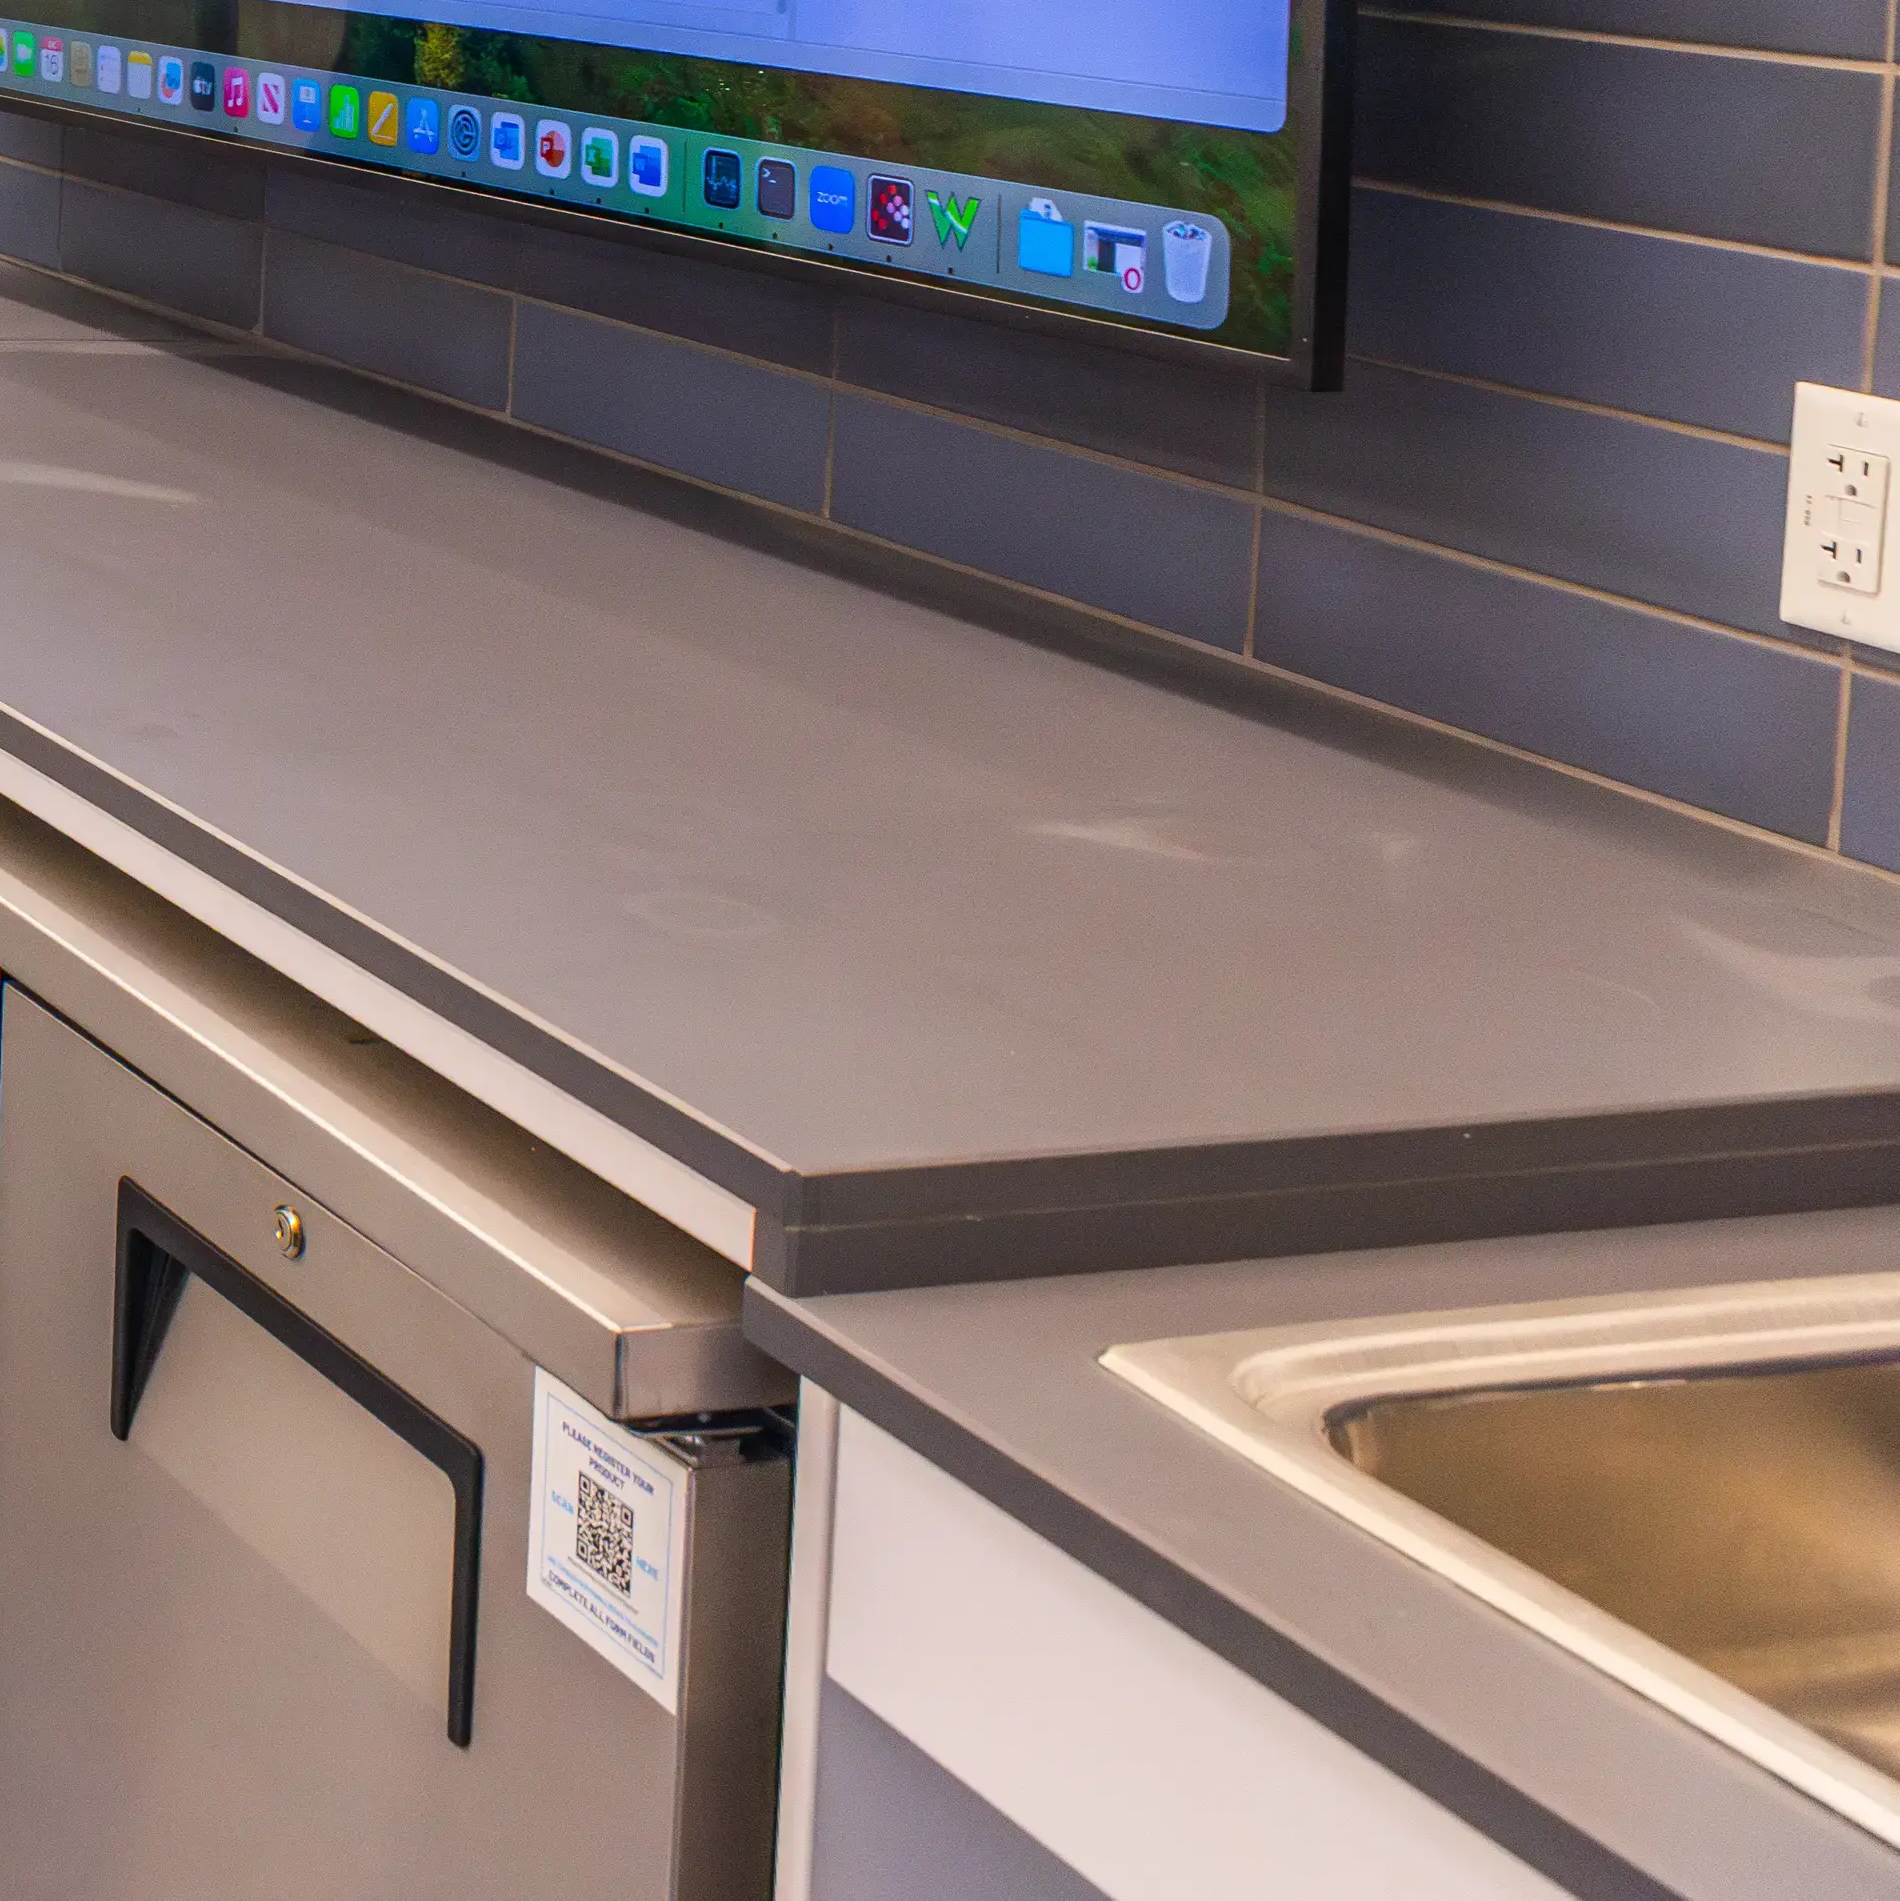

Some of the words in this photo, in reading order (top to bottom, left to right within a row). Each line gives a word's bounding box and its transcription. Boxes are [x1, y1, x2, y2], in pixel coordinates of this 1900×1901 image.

[816, 190, 849, 208] zoom
[588, 1455, 624, 1492] PRODUCT
[593, 1442, 630, 1480] REGISTER
[631, 1470, 654, 1497] YOUR
